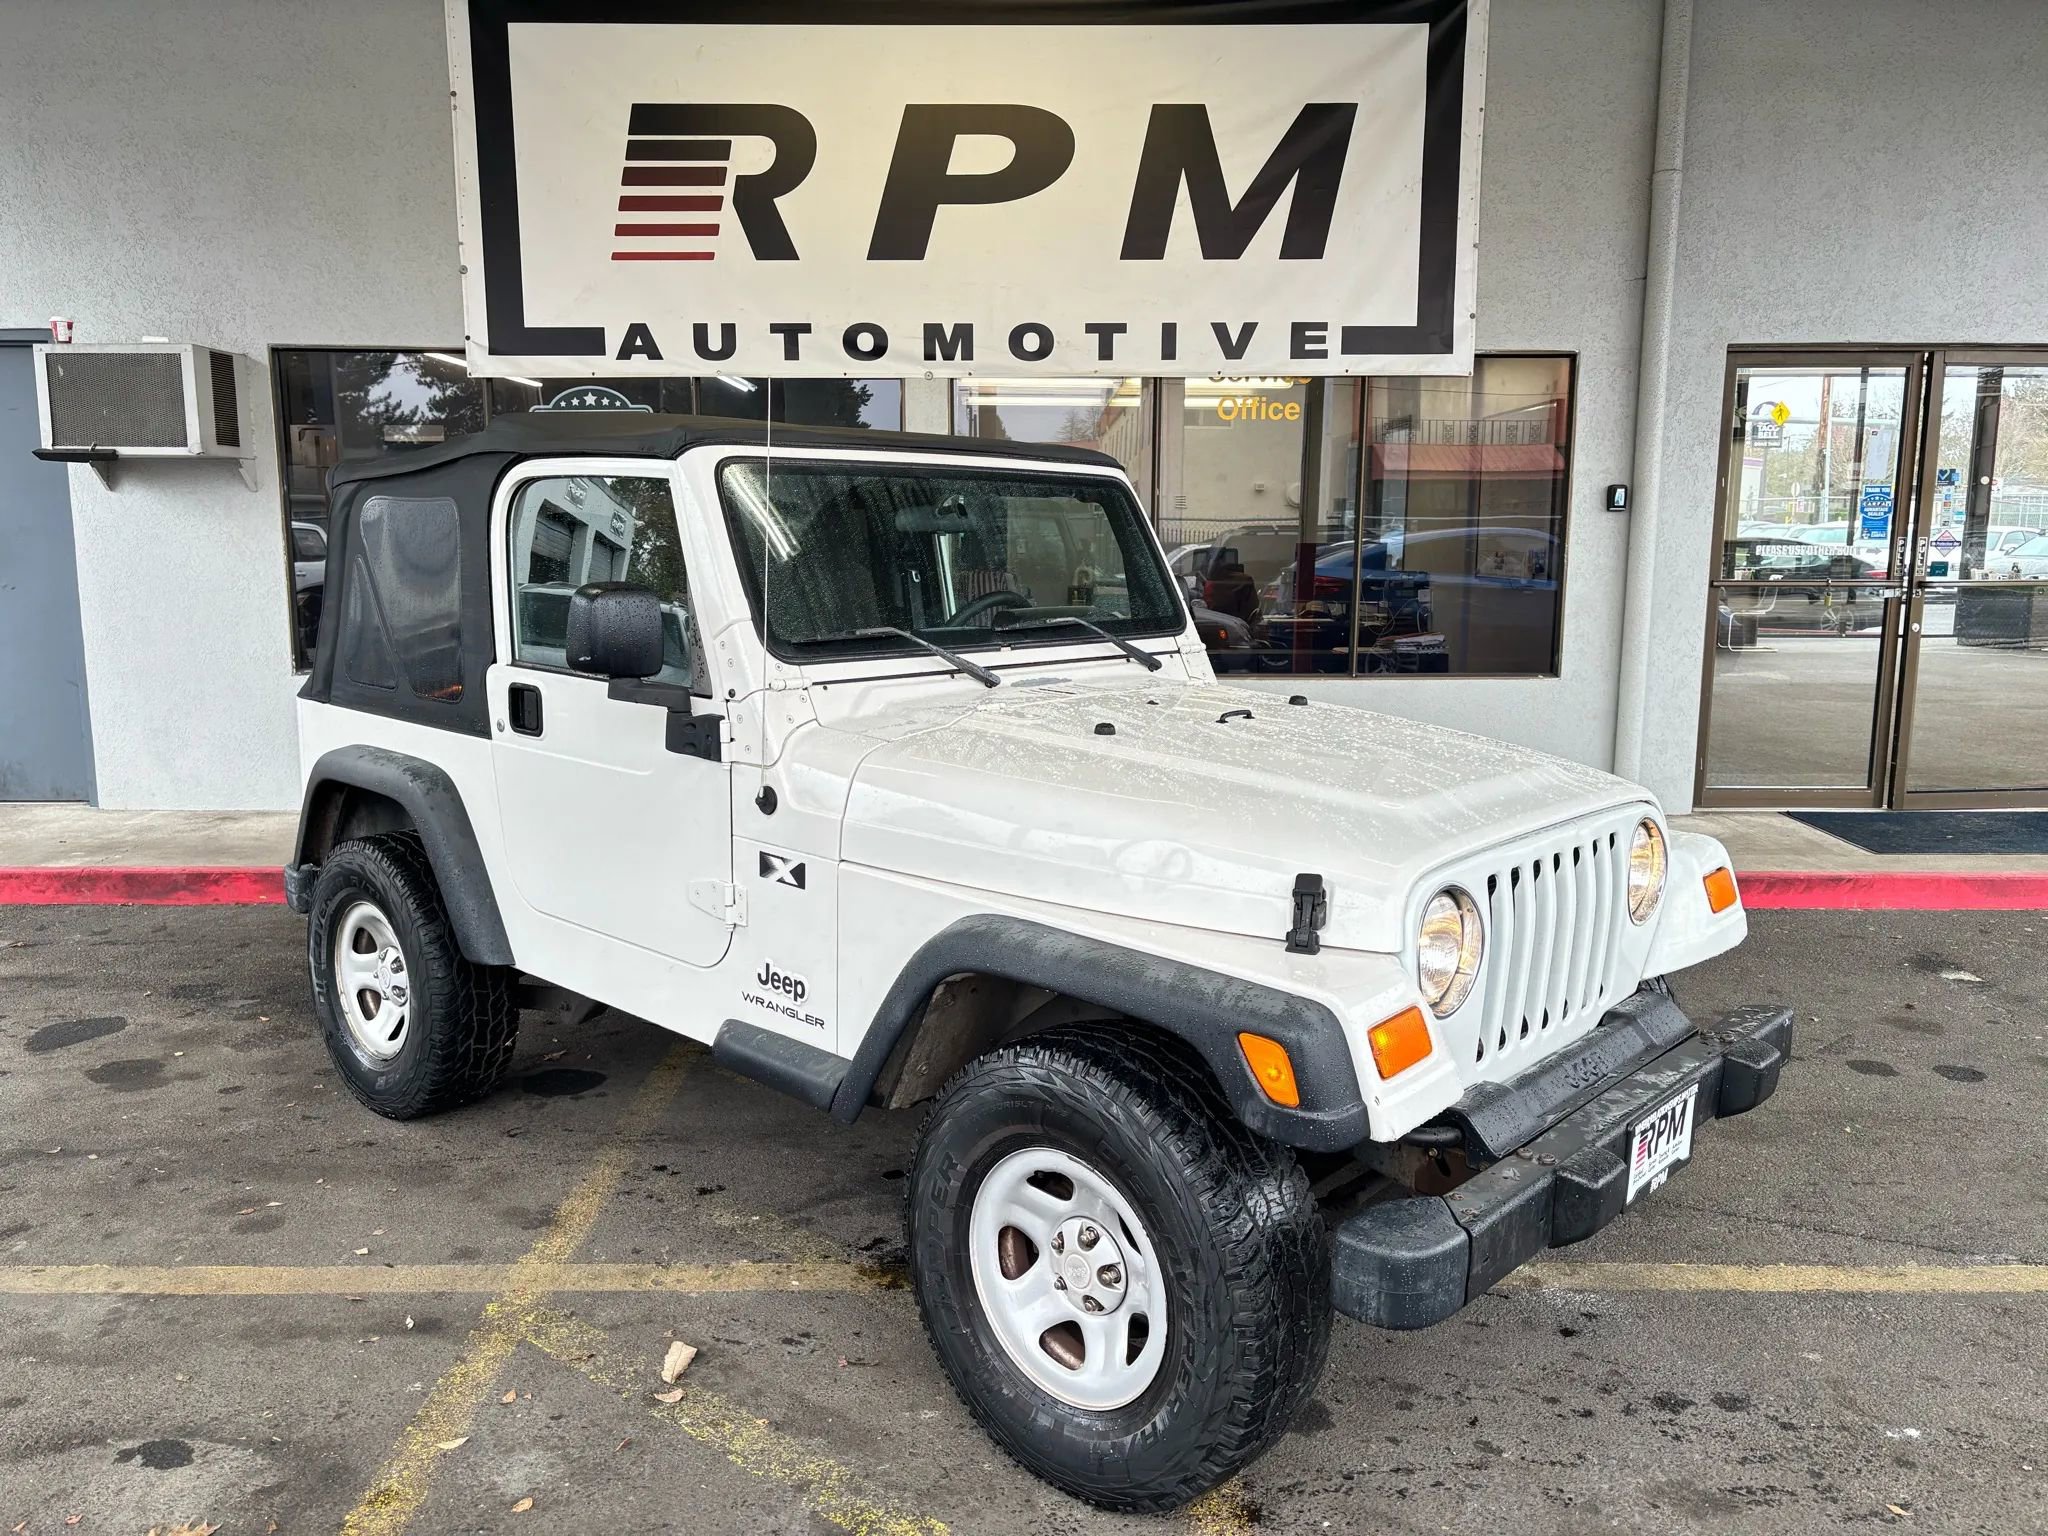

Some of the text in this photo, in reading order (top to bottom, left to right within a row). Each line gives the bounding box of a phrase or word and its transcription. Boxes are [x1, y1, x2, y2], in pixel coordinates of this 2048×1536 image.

[611, 103, 1358, 260] RPM
[616, 322, 1328, 361] AUTOMOTIVE
[1217, 396, 1300, 420] Office
[1756, 545, 1787, 556] PLEASE
[1788, 545, 1806, 556] USE
[1918, 539, 1926, 566] PULL
[757, 962, 806, 1002] Jeep
[742, 991, 825, 1029] WRANGLER
[1635, 1098, 1688, 1170] RPM
